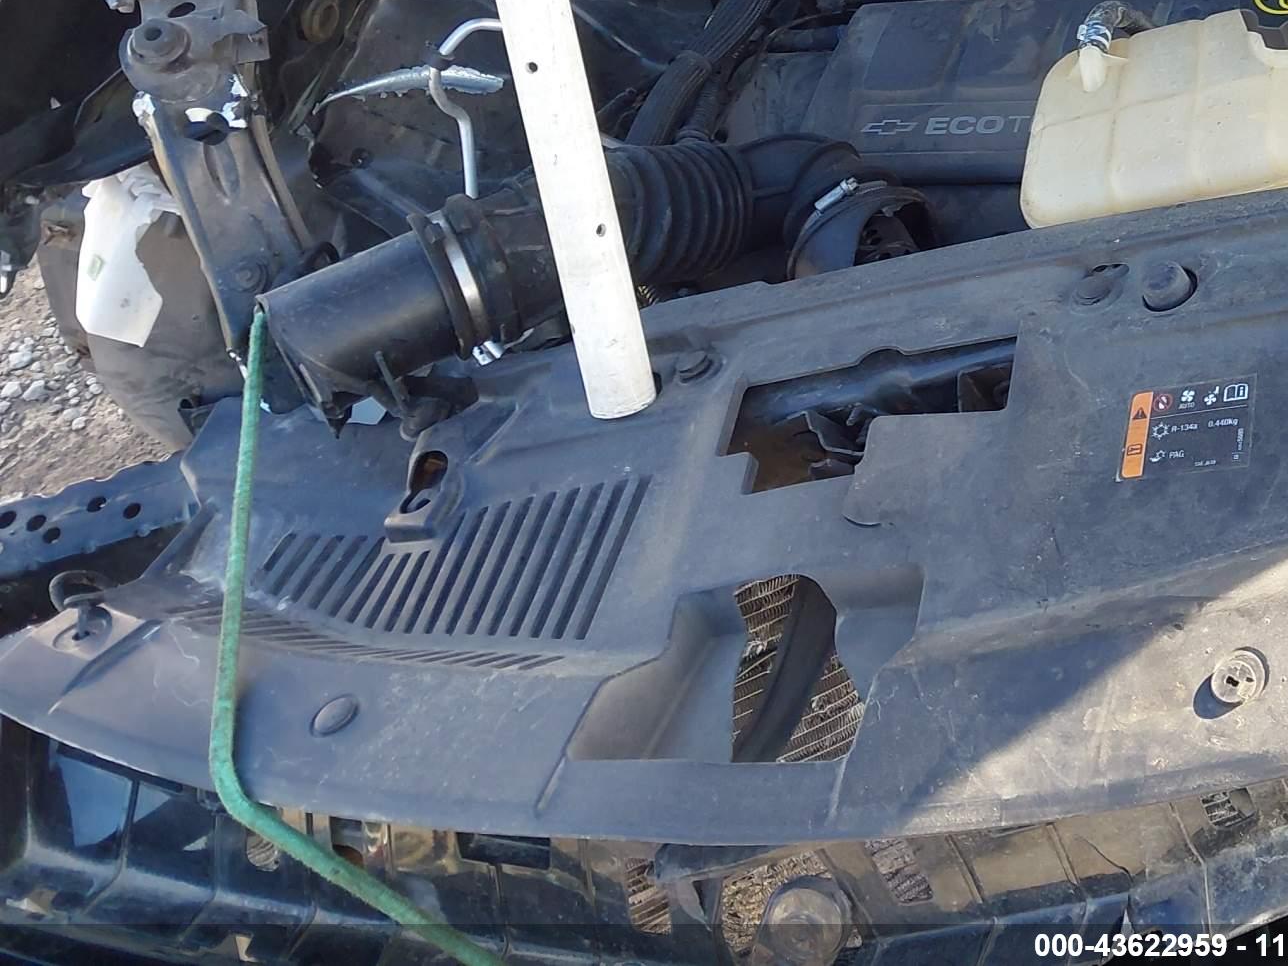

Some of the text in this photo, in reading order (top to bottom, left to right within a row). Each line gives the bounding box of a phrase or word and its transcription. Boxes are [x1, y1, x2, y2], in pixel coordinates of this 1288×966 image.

[925, 115, 1032, 134] ECOT
[1171, 423, 1198, 432] R-134a
[1168, 450, 1185, 458] PAG
